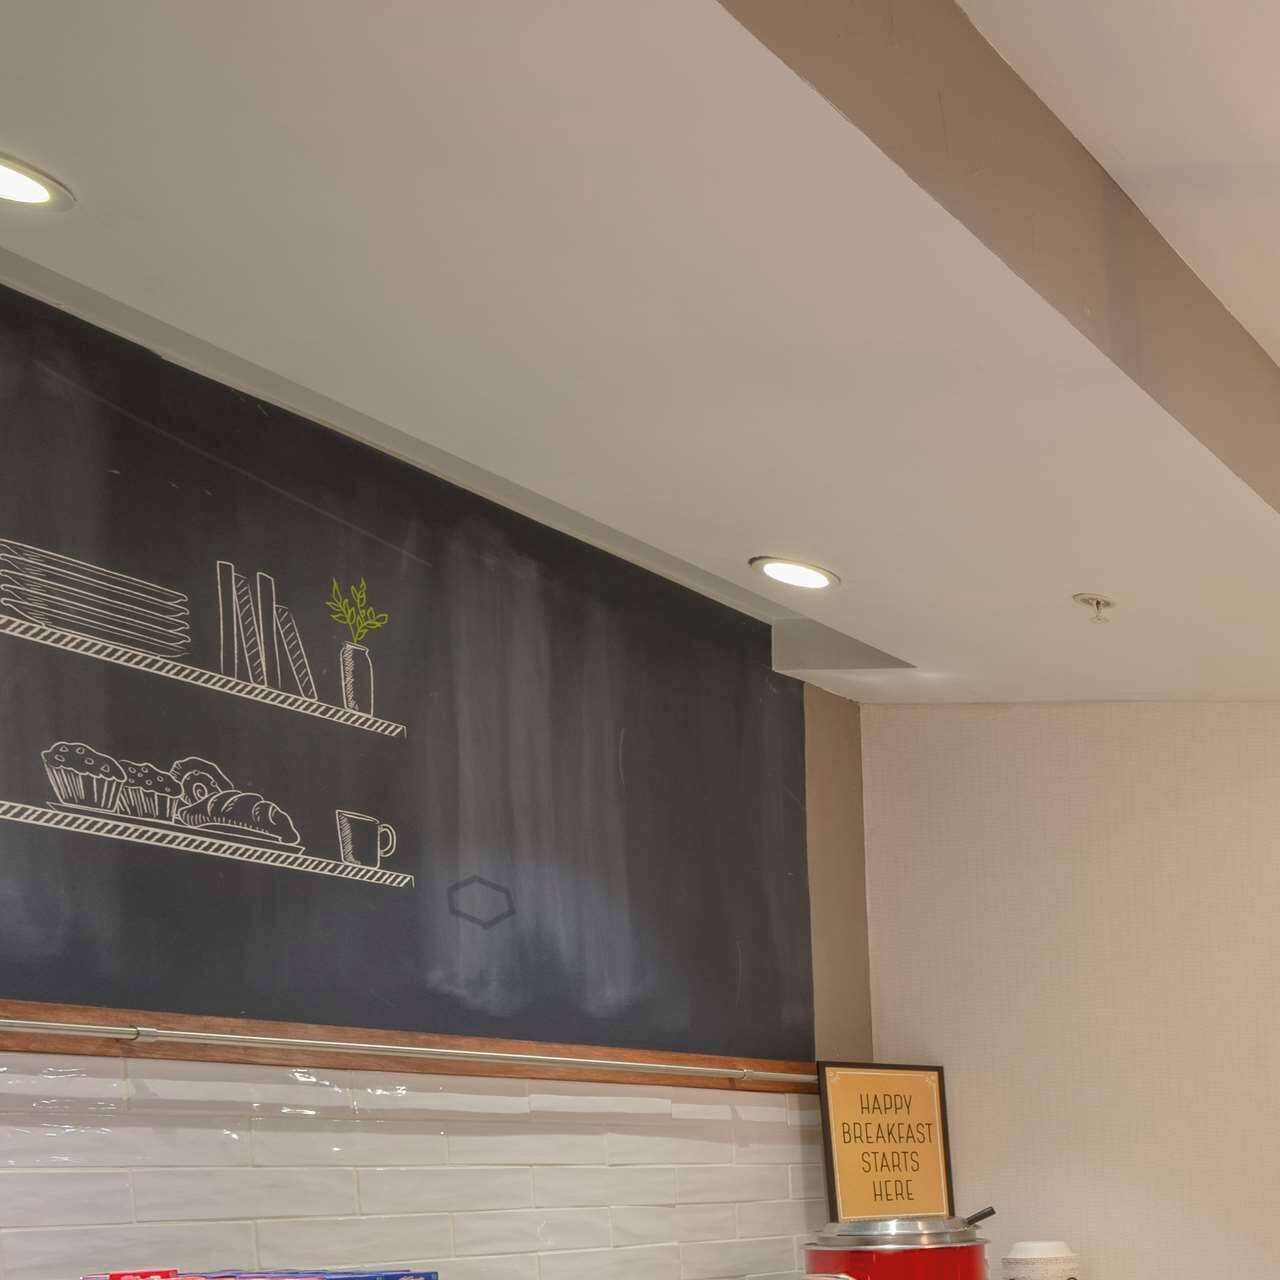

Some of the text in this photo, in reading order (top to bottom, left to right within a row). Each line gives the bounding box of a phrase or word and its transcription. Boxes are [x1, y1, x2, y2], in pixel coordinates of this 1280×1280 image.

[859, 1093, 913, 1115] HAPPY
[841, 1122, 933, 1144] BREAKFAST
[861, 1151, 920, 1173] STARTS
[872, 1179, 915, 1202] HERE
